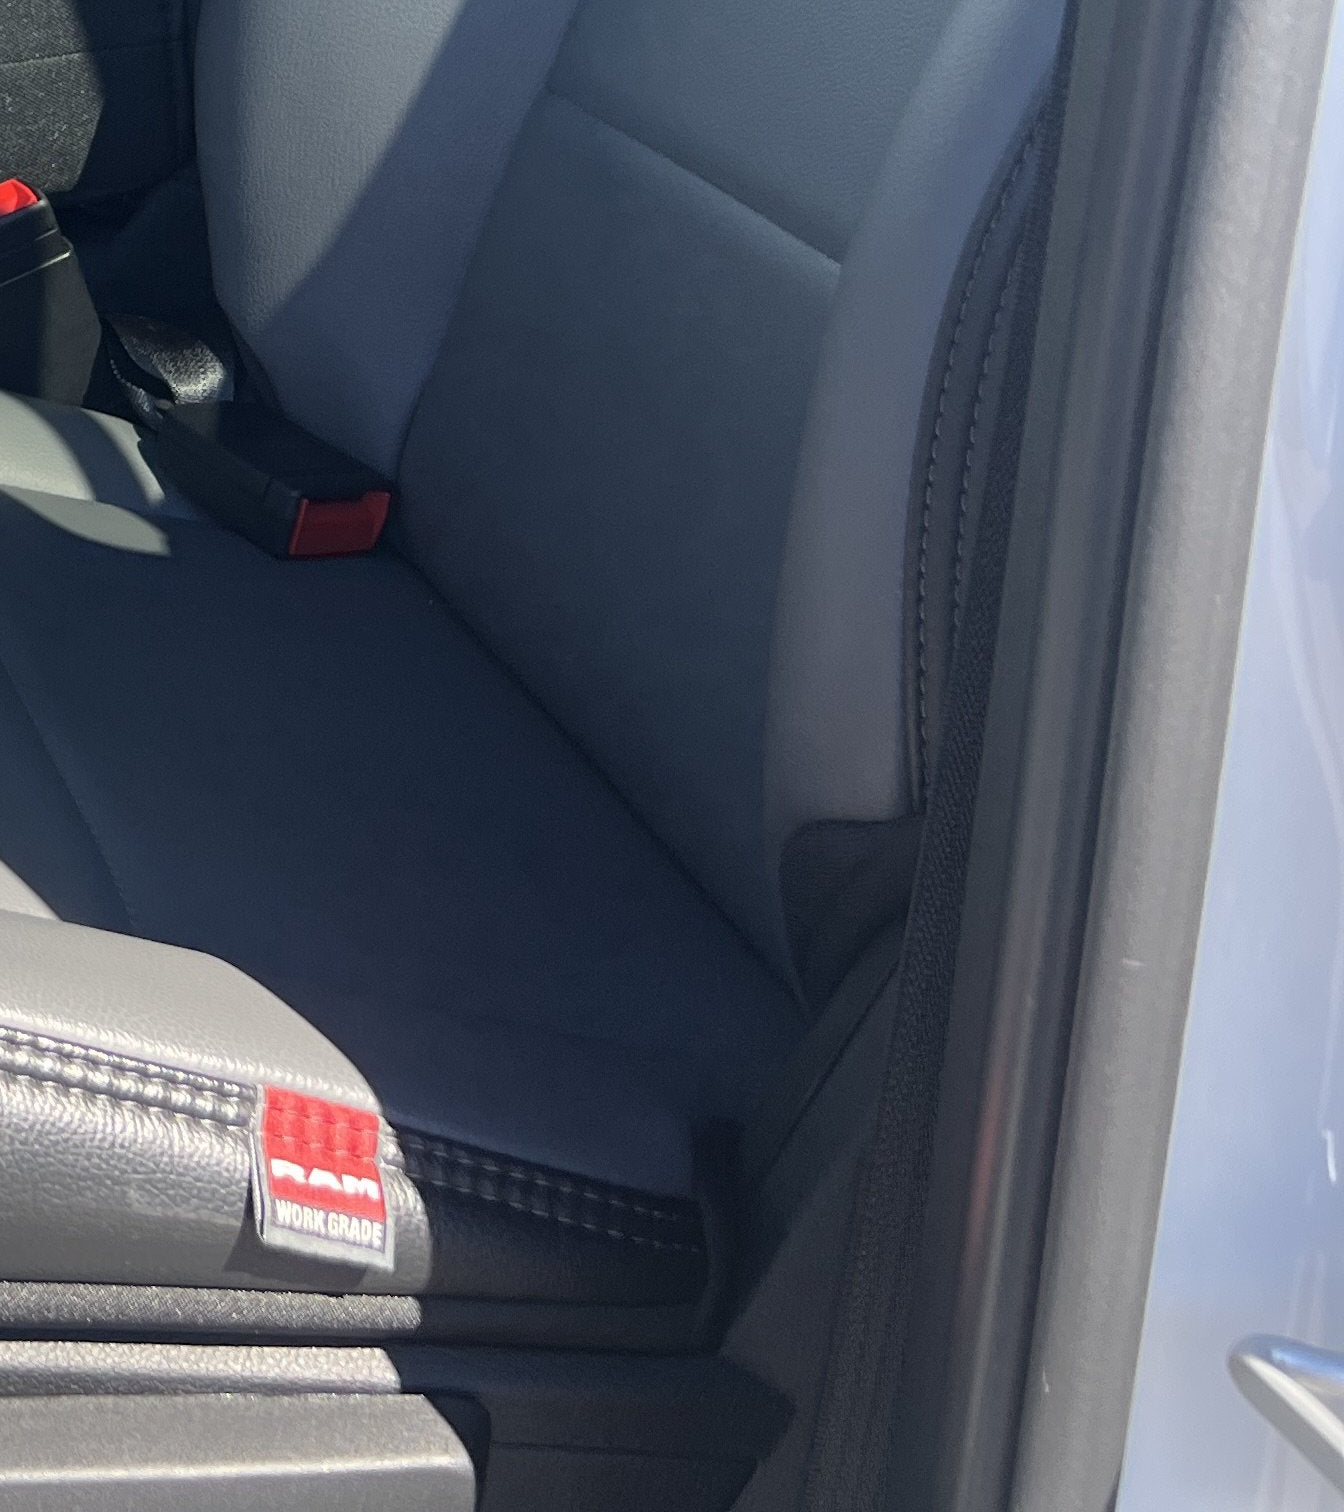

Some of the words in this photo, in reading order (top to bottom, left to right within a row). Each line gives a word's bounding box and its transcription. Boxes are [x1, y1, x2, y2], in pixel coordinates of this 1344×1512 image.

[270, 1158, 380, 1201] RAM
[275, 1199, 326, 1235] WORK
[327, 1211, 384, 1248] GRADE
